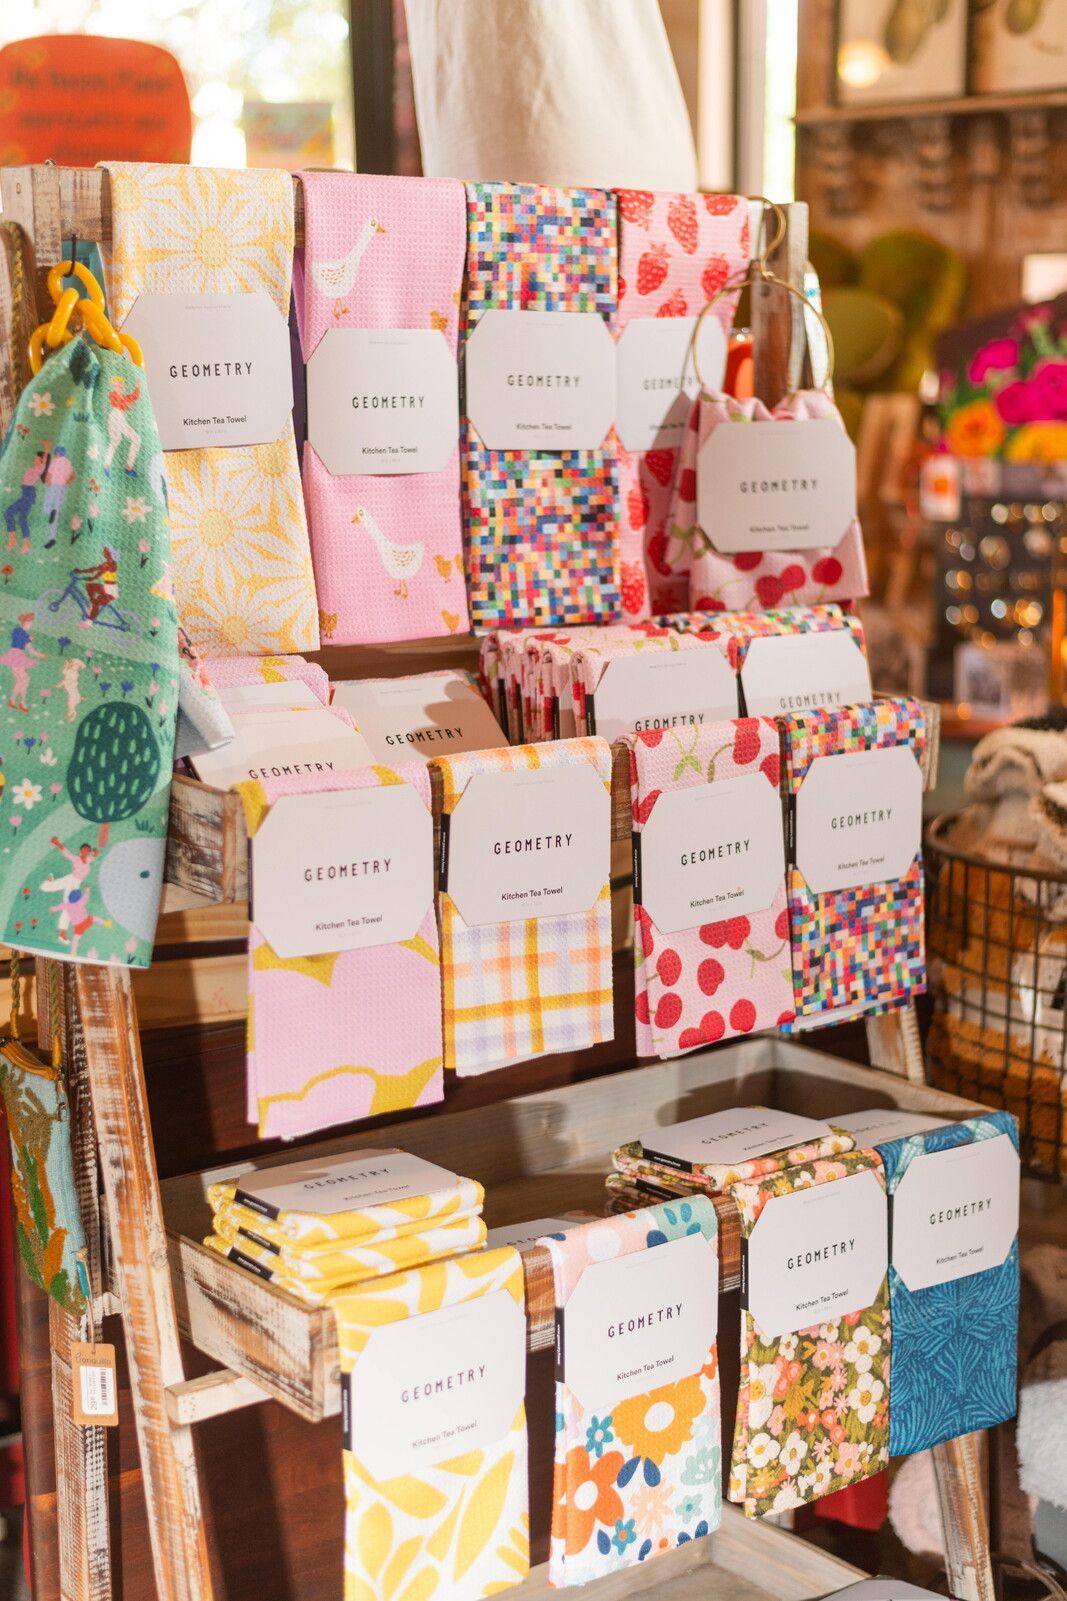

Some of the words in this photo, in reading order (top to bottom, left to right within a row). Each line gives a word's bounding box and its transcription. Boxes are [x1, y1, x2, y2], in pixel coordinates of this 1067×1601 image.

[169, 362, 252, 378] GEOMETRY
[507, 374, 580, 387] GEOMETRY
[352, 396, 424, 409] GEOMETRY
[183, 418, 211, 426] Kitchen
[212, 416, 225, 424] Tea
[226, 415, 247, 423] Towel
[388, 446, 399, 454] Tea
[740, 479, 817, 493] GEOMETRY
[780, 691, 840, 709] GEOMETRY
[635, 714, 704, 732] GEOMETRY
[385, 728, 463, 745] GEOMETRY
[249, 762, 334, 779] GEOMETRY
[831, 808, 892, 829] GEOMETRY
[494, 834, 572, 855] GEOMETRY
[681, 838, 750, 866] GEOMETRY
[304, 858, 391, 882] GEOMETRY
[501, 891, 529, 901] Kitchen
[530, 889, 541, 897] Tea
[543, 886, 563, 895] Towel
[690, 897, 714, 908] Kitchen
[715, 894, 726, 902] Tea
[726, 889, 744, 899] Towel
[316, 922, 345, 931] Kitchen
[347, 919, 360, 927] Tea
[361, 914, 383, 924] Towel
[701, 1123, 768, 1144] GEOMETRY
[304, 1168, 390, 1190] GEOMETRY
[930, 1198, 991, 1225] GEOMETRY
[787, 1238, 855, 1269] GEOMETRY
[795, 1299, 819, 1311] Kitchen
[820, 1295, 831, 1303] Tea
[832, 1289, 849, 1299] Towel
[608, 1303, 682, 1338] GEOMETRY
[616, 1368, 642, 1381] Kitchen
[643, 1363, 654, 1372] Tea
[655, 1355, 674, 1367] Towel
[401, 1364, 486, 1403] GEOMETRY
[412, 1434, 441, 1448] Kitchen
[442, 1430, 455, 1439] Tea
[456, 1420, 478, 1433] Towel
